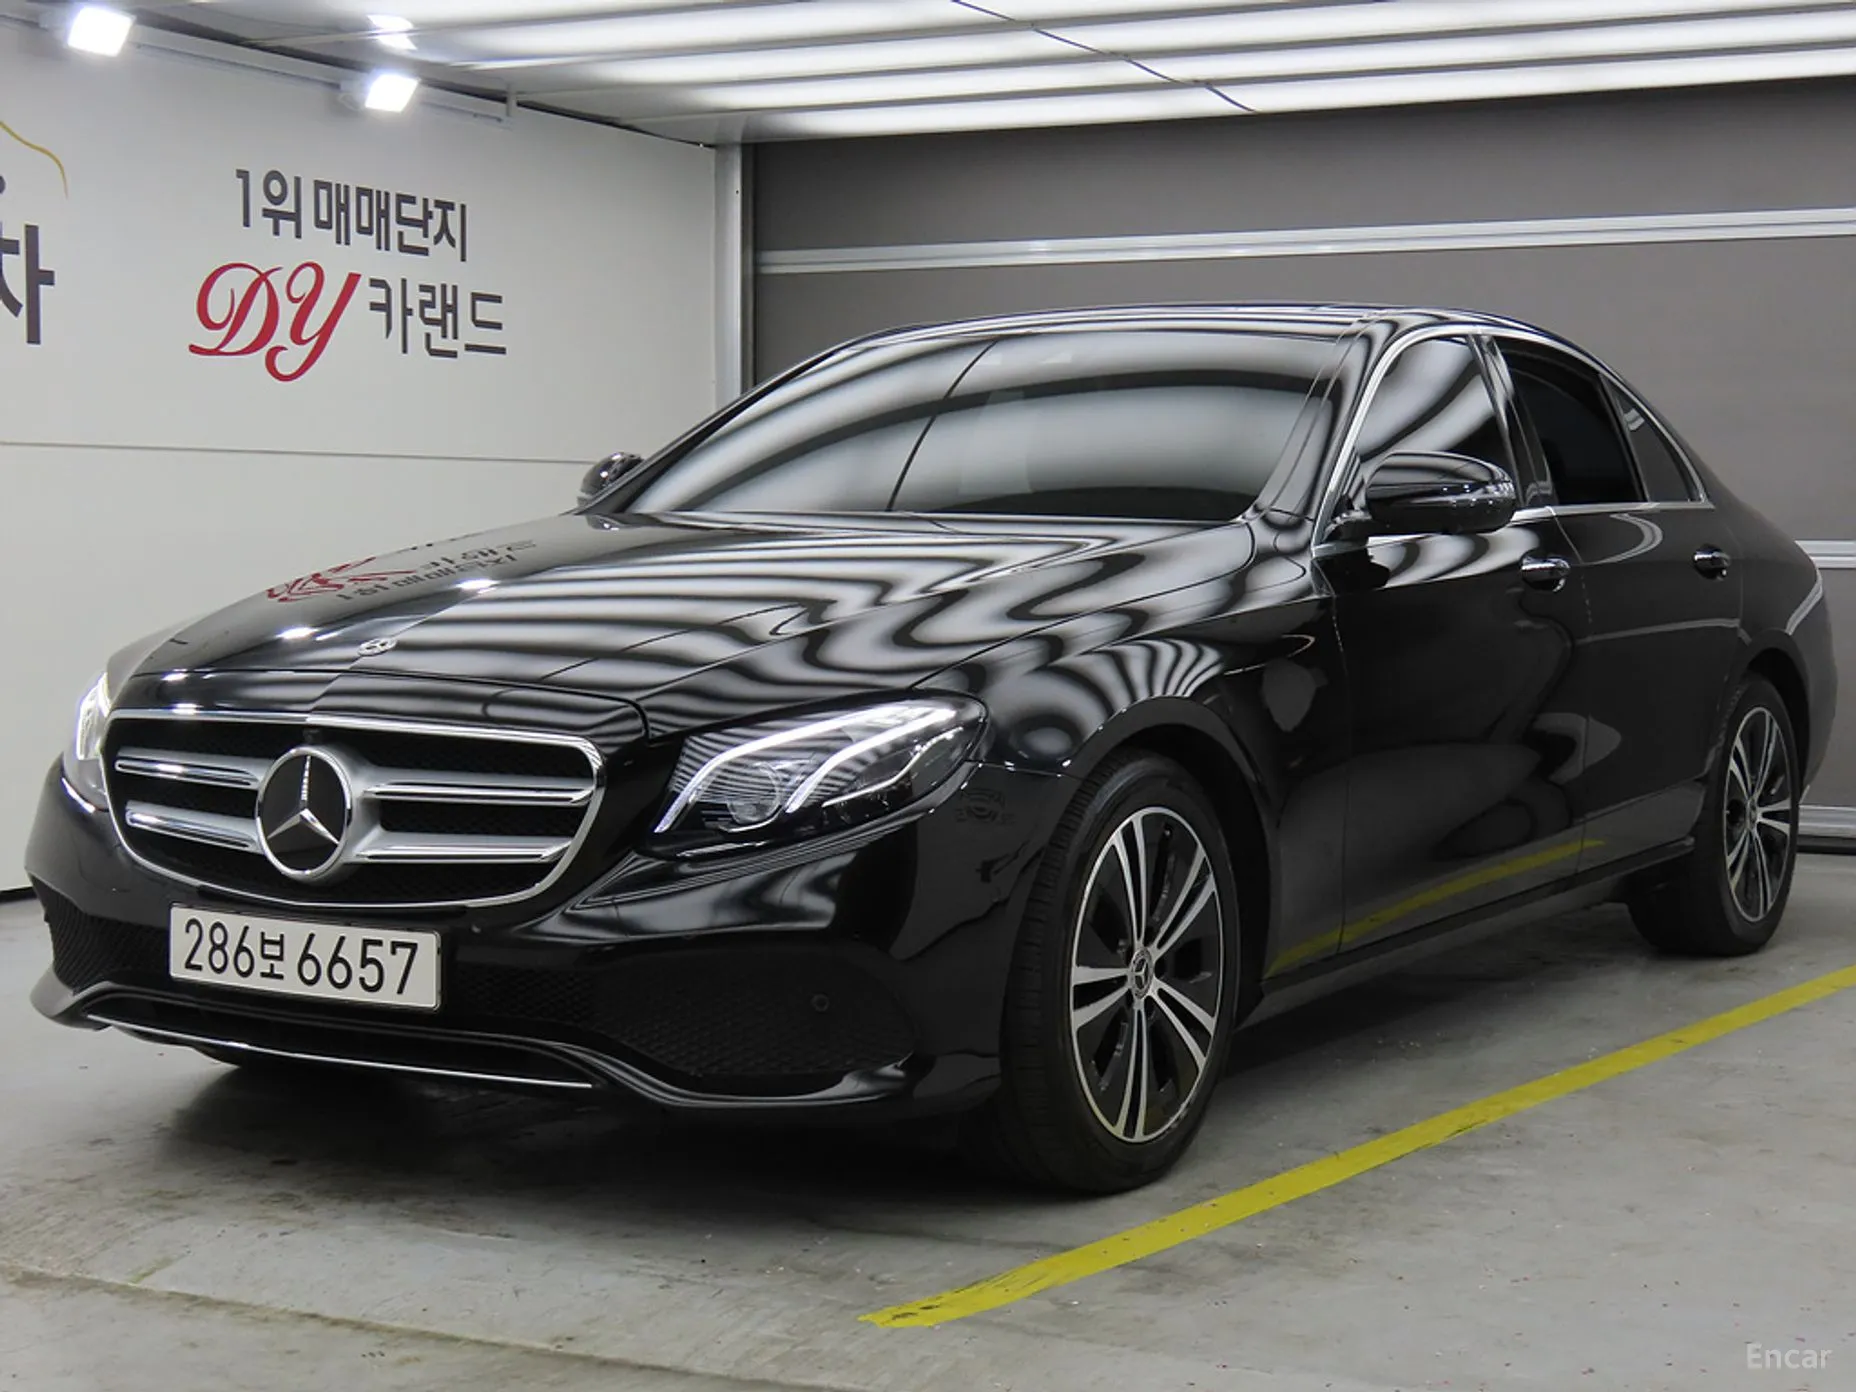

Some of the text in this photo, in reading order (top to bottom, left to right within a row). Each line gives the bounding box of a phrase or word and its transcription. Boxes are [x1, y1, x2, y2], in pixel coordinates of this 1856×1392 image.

[235, 168, 467, 262] 1위 매매단지
[188, 261, 507, 382] DY 카랜드
[184, 917, 419, 995] 286보 6657
